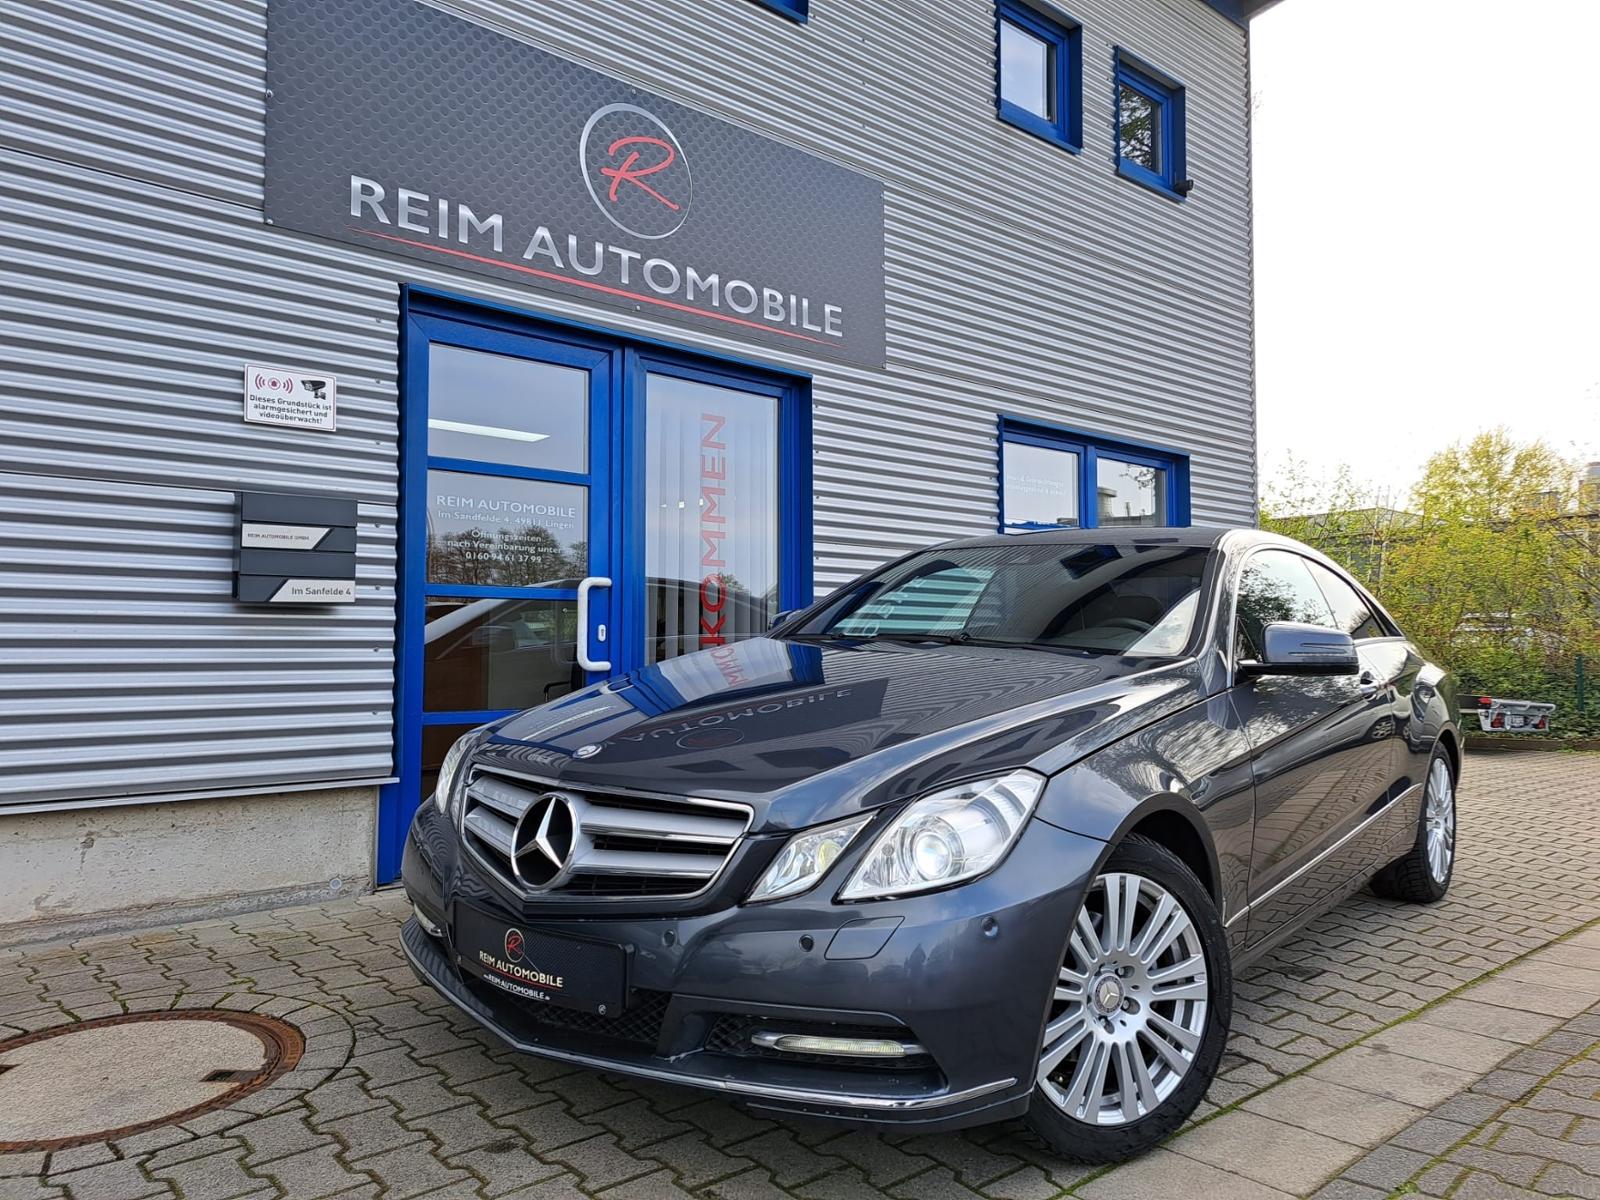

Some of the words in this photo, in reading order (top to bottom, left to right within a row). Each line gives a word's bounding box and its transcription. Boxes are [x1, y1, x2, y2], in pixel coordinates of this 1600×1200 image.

[600, 135, 682, 210] R
[350, 174, 503, 253] REIM
[522, 225, 844, 338] AUTOMOBILE
[249, 394, 276, 404] Dieses
[277, 397, 321, 410] Grundstück
[253, 403, 312, 416] alarmgesichert
[313, 410, 328, 418] und
[259, 411, 323, 424] videoüberwacht!
[436, 495, 474, 508] REIM
[478, 499, 576, 518] AUTOMOBILE
[438, 510, 451, 519] Im
[454, 511, 501, 523] Sandfelde
[545, 519, 574, 530] Lingen
[447, 539, 471, 548] nach
[472, 540, 536, 554] Vereinbarung
[291, 587, 303, 595] Im
[305, 587, 344, 595] Sanfelde
[479, 950, 496, 967] REIM
[496, 959, 564, 988] AUTOMOBILE
